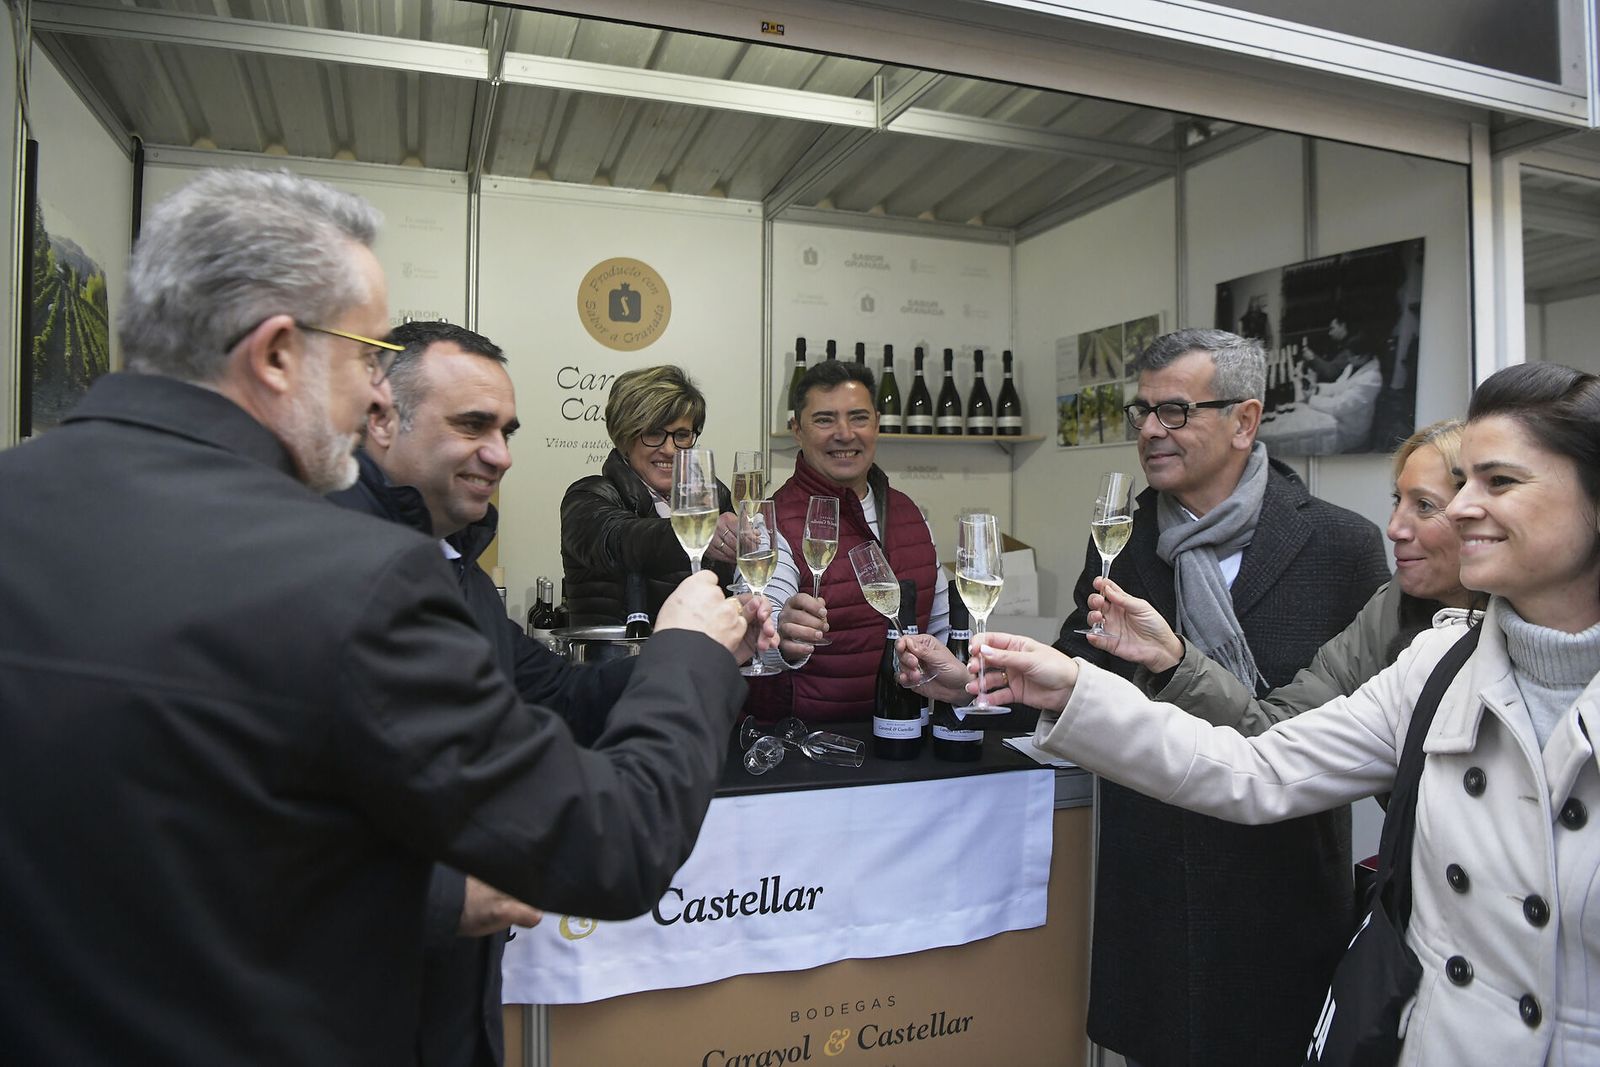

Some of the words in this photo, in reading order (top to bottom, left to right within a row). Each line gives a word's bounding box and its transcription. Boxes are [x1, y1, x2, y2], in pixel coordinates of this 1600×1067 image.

[557, 366, 615, 391] Car
[546, 438, 579, 449] Vinos
[581, 438, 615, 449] autóc
[652, 875, 824, 926] Castellar
[789, 995, 897, 1024] BODEGAS
[702, 1034, 813, 1067] Carayol
[823, 1028, 851, 1057] &
[857, 1011, 974, 1051] Castellar
